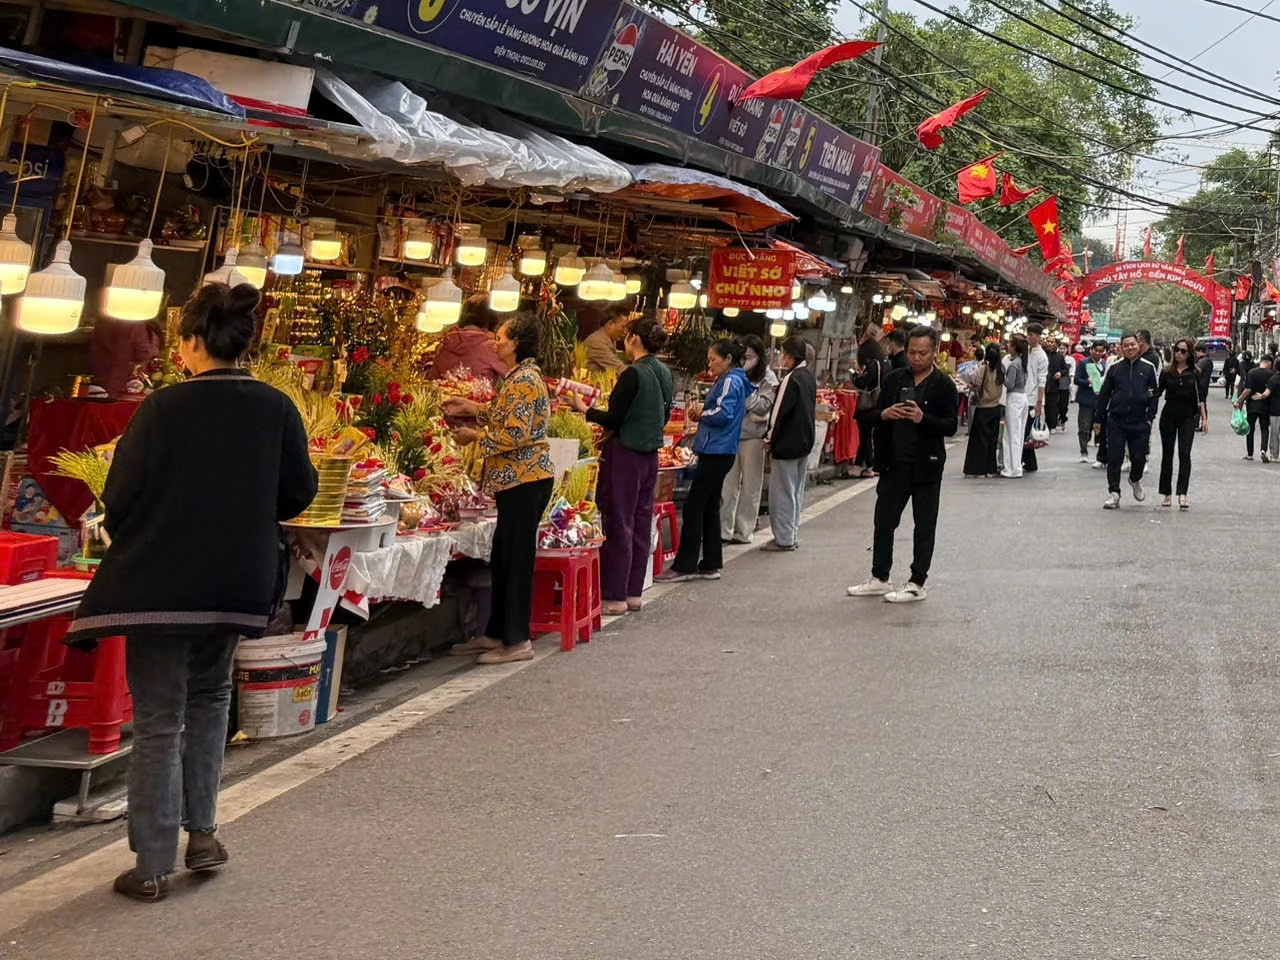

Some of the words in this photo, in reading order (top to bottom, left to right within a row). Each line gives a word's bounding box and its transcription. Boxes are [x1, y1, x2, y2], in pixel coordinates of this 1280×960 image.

[459, 8, 486, 27] CHUYÊN
[504, 24, 523, 41] VÀNG
[520, 32, 542, 48] HƯƠNG
[539, 39, 553, 53] HOA
[562, 48, 579, 63] BÁNH
[577, 54, 589, 67] KẸO
[608, 46, 632, 68] PEPSI
[656, 34, 680, 67] HẢI
[675, 44, 699, 78] YẾN
[699, 71, 721, 127] 4
[799, 126, 816, 170] 5
[722, 261, 758, 279] VIẾT
[1113, 270, 1128, 283] TÂY
[1166, 273, 1183, 285] KIM
[1181, 278, 1206, 294] NGƯU
[715, 281, 750, 296] CHỮ
[750, 284, 787, 298] NHO
